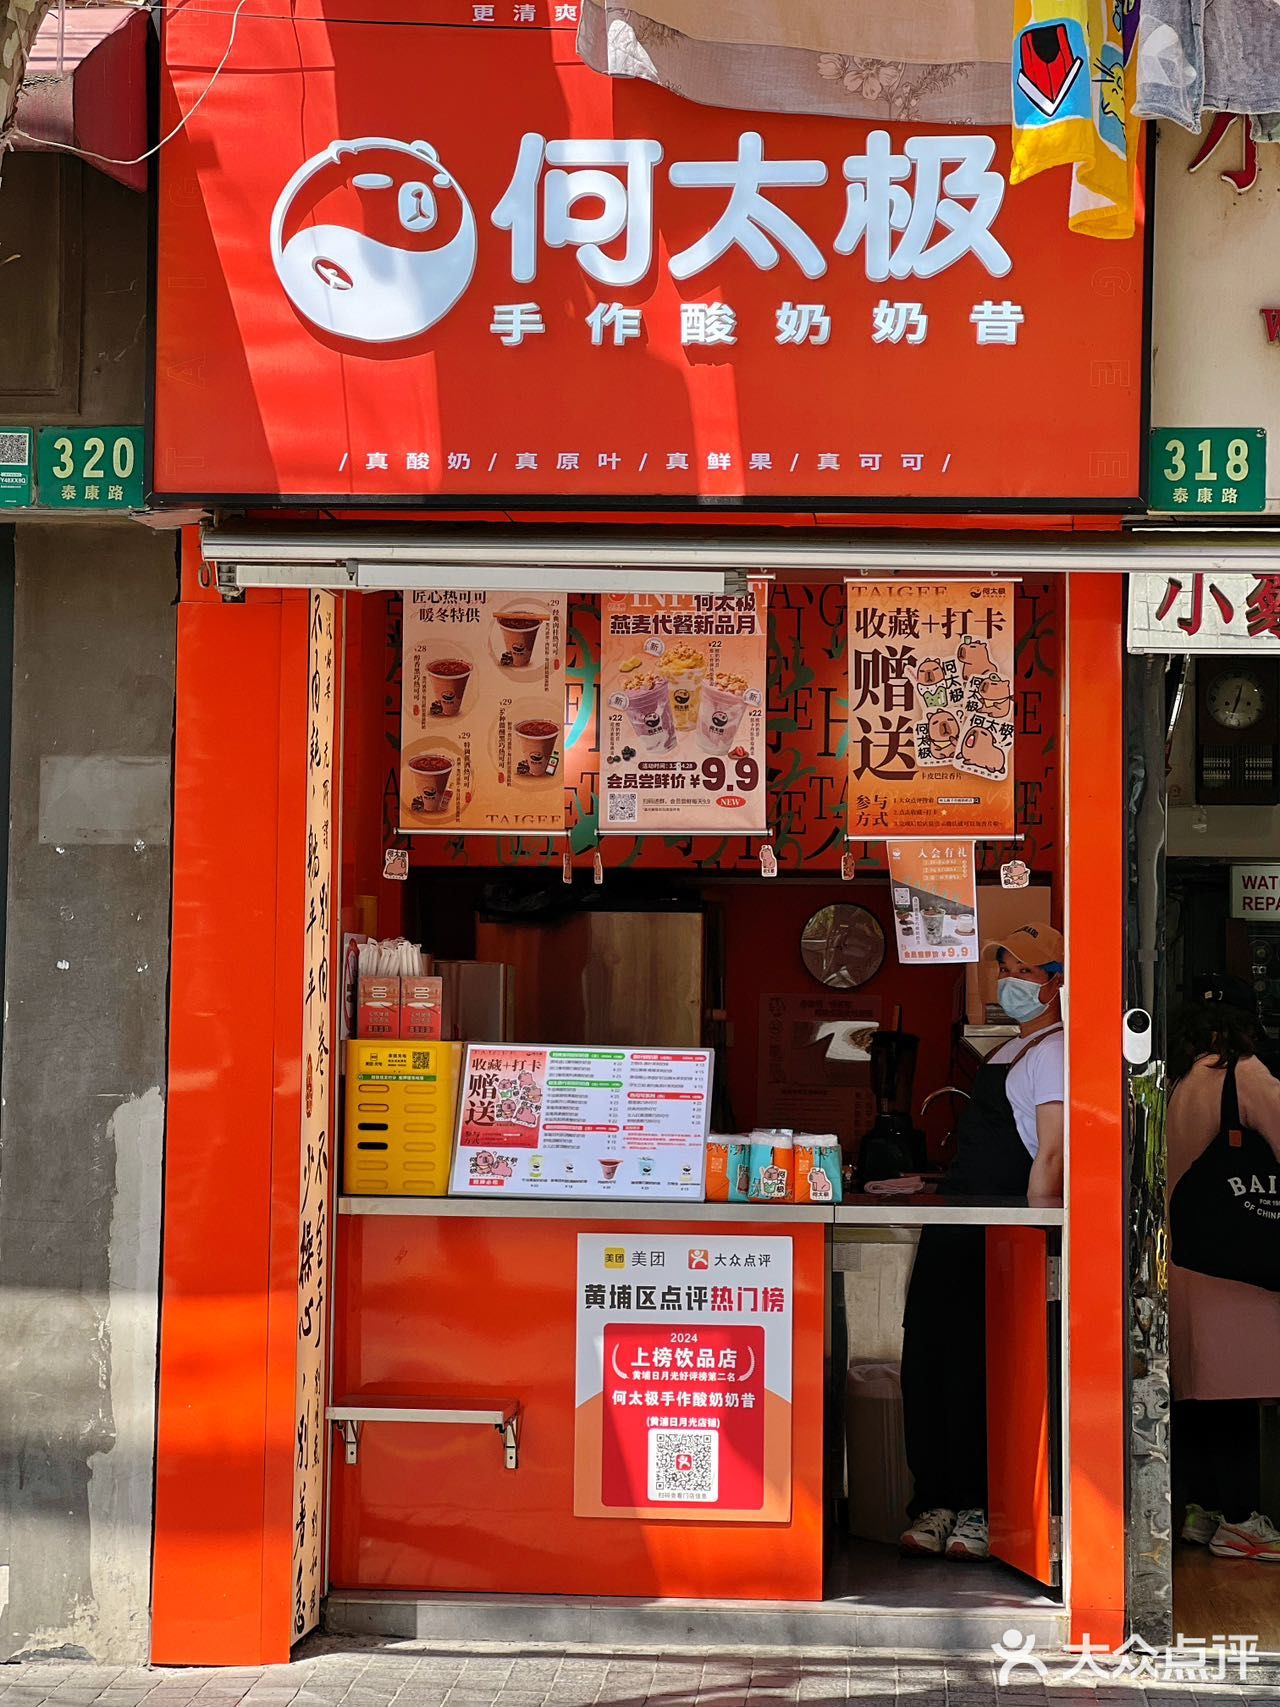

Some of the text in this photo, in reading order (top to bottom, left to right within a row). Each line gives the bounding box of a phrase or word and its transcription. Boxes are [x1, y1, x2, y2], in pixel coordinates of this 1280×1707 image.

[472, 4, 577, 21] 更清爽
[490, 129, 1013, 286] 何太极
[490, 301, 1025, 346] 手作酸奶奶昔
[52, 437, 135, 479] 320
[1163, 439, 1249, 481] 318
[61, 485, 124, 500] 泰康路
[1172, 488, 1238, 503] 泰康路
[419, 607, 481, 623] 暖冬特供
[610, 614, 755, 635] 燕麦代餐新品月
[855, 607, 1007, 640] 收藏+打卡
[607, 773, 686, 789] 会员尝鲜价
[719, 798, 741, 806] NEW
[856, 794, 888, 810] 参与
[856, 811, 888, 827] 方式
[1241, 875, 1279, 890] WAT
[472, 1058, 542, 1073] 收藏+打卡
[1244, 1201, 1256, 1211] OF
[631, 1251, 665, 1267] 美团
[714, 1253, 772, 1268] 大众点评
[585, 1284, 785, 1312] 黄埔区点评热门榜
[670, 1333, 698, 1343] 2024
[631, 1347, 737, 1368] 上榜饮品店
[612, 1390, 756, 1409] 何太极手作酸奶奶昔
